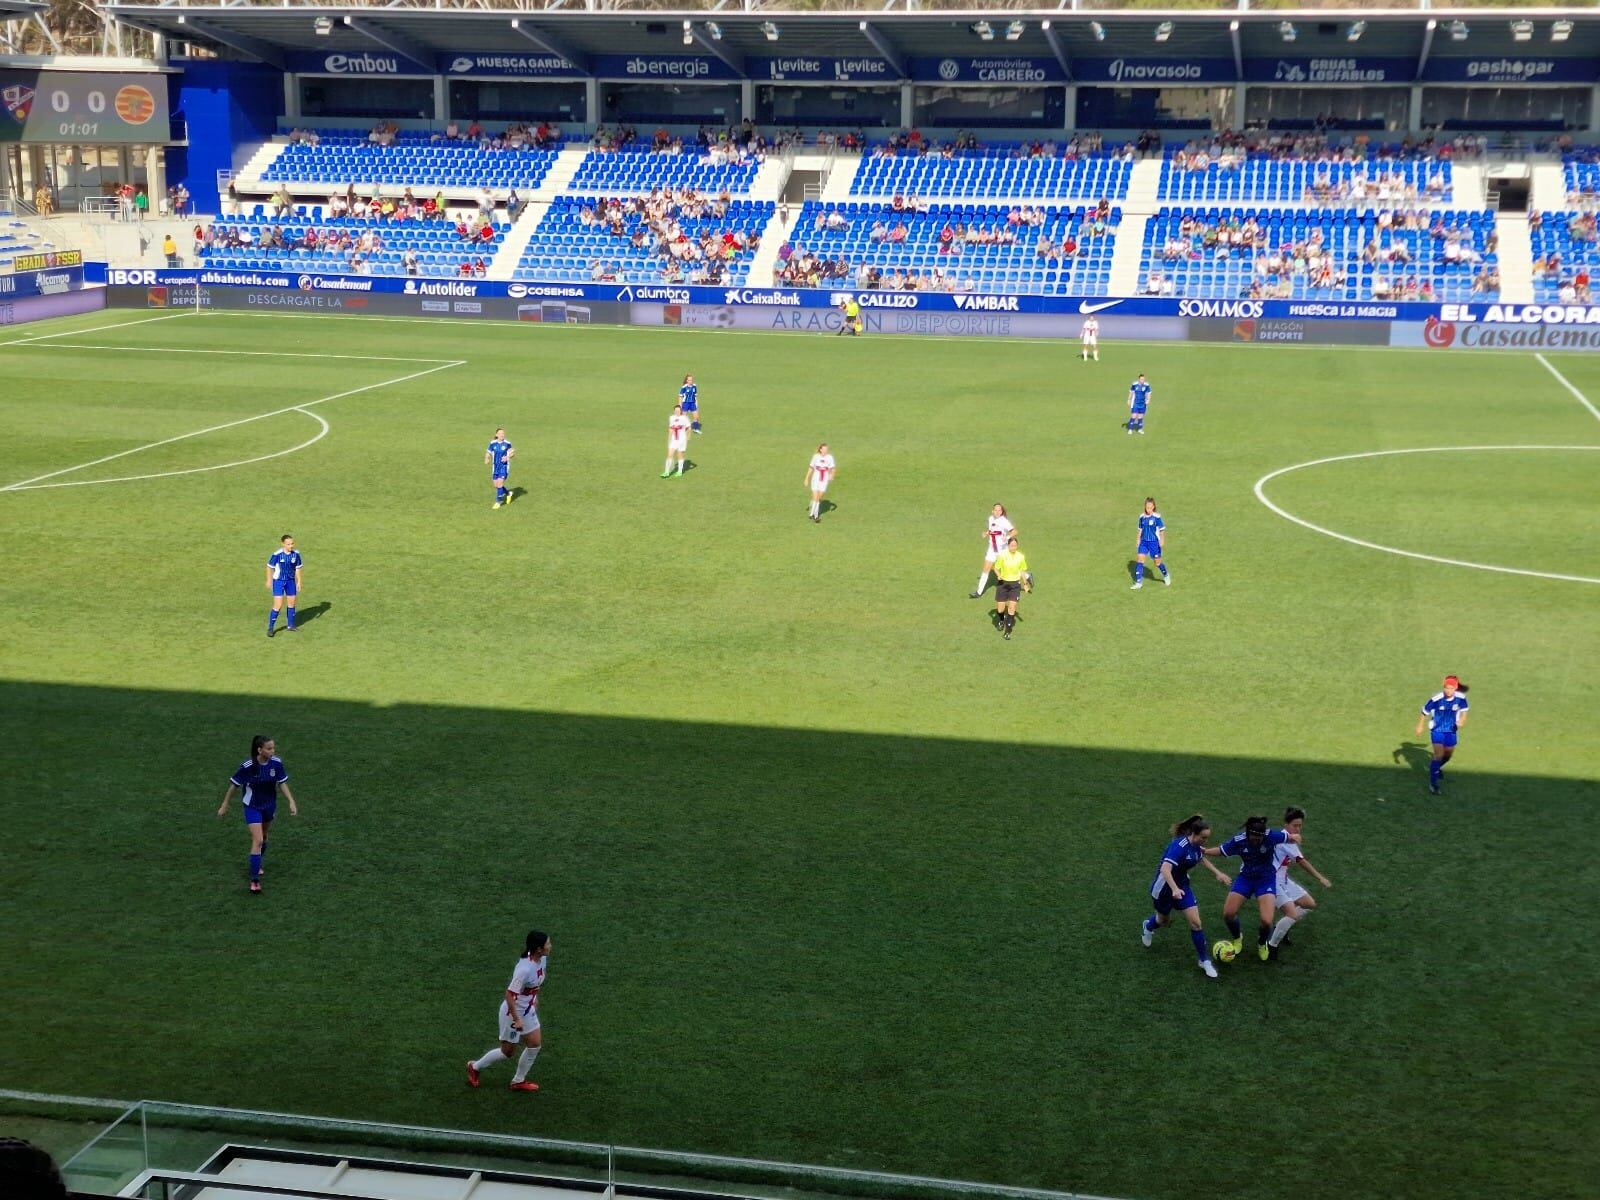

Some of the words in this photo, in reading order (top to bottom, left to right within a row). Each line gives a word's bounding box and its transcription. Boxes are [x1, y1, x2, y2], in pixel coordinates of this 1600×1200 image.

[324, 53, 397, 72] embou
[476, 57, 527, 68] HUESCA
[528, 58, 573, 69] GARDE
[626, 57, 709, 77] abenergía
[778, 59, 820, 72] levitec
[842, 59, 886, 72] levitec
[971, 59, 1032, 68] Automóviles
[978, 69, 1046, 81] CABRERO
[1124, 64, 1202, 77] navasola
[51, 90, 70, 113] 0
[87, 91, 106, 113] 0
[59, 123, 98, 136] 01:01
[16, 255, 47, 271] GRADA
[36, 272, 70, 287] Alcampo
[108, 270, 157, 285] IBOR
[200, 272, 289, 287] abbahotels.com
[313, 277, 372, 291] Casademont
[419, 282, 477, 297] Autolíder
[527, 286, 584, 297] COSEHISA
[636, 286, 690, 300] alumbra
[327, 298, 342, 308] LA
[742, 290, 800, 306] CaixaBank
[858, 294, 918, 308] CALLIZO
[965, 296, 1019, 311] AMBAR
[1178, 299, 1264, 318] SOMMOS
[1440, 304, 1477, 321] EL
[771, 310, 882, 332] ARAGN
[896, 313, 1011, 336] DEPORTE
[1260, 331, 1304, 341] DEPORTE
